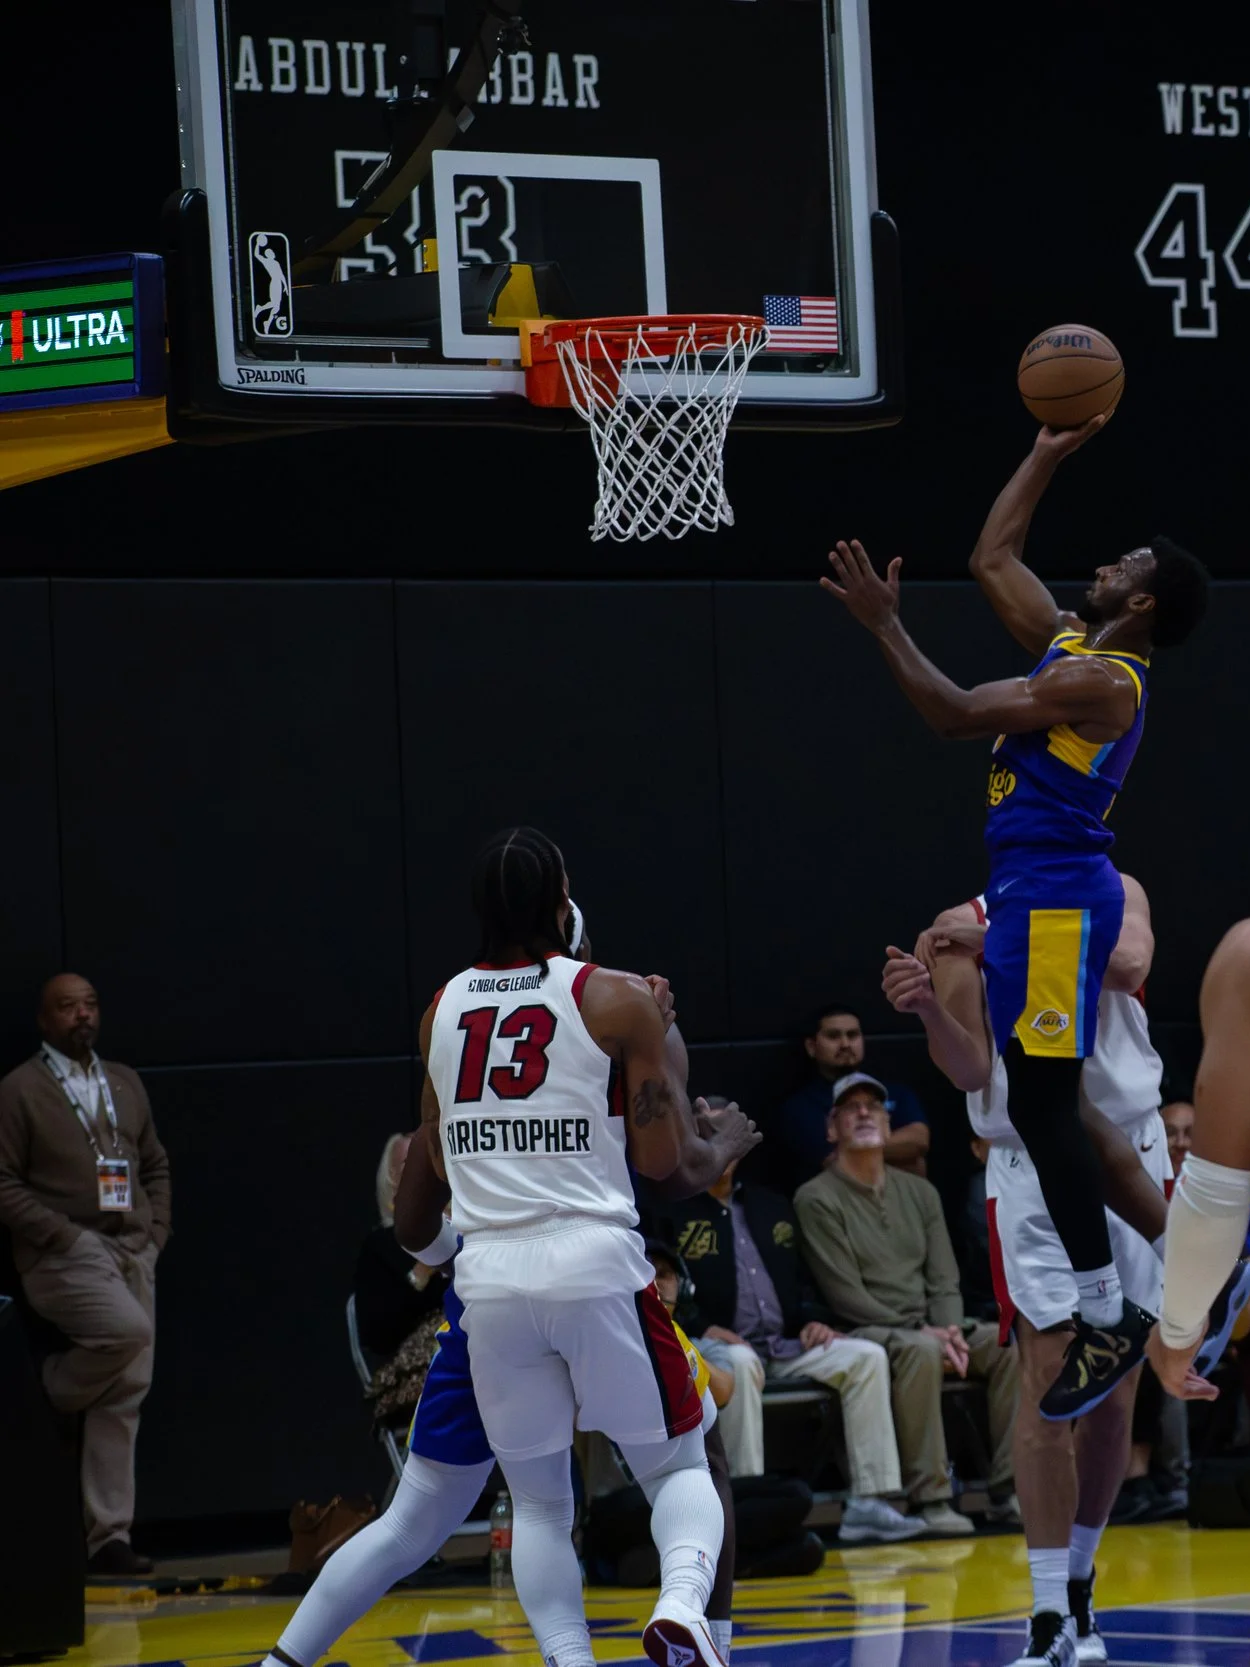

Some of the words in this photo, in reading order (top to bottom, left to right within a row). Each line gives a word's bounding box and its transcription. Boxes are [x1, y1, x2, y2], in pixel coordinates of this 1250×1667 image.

[234, 35, 399, 99] ABDUL
[31, 309, 125, 353] ULTRA
[275, 316, 288, 331] G
[236, 367, 306, 385] SPALDING
[475, 978, 496, 993] NBA
[495, 978, 511, 993] G
[510, 975, 541, 992] LEAGUE
[454, 1004, 557, 1104] 13
[447, 1118, 590, 1156] RISTOPHER
